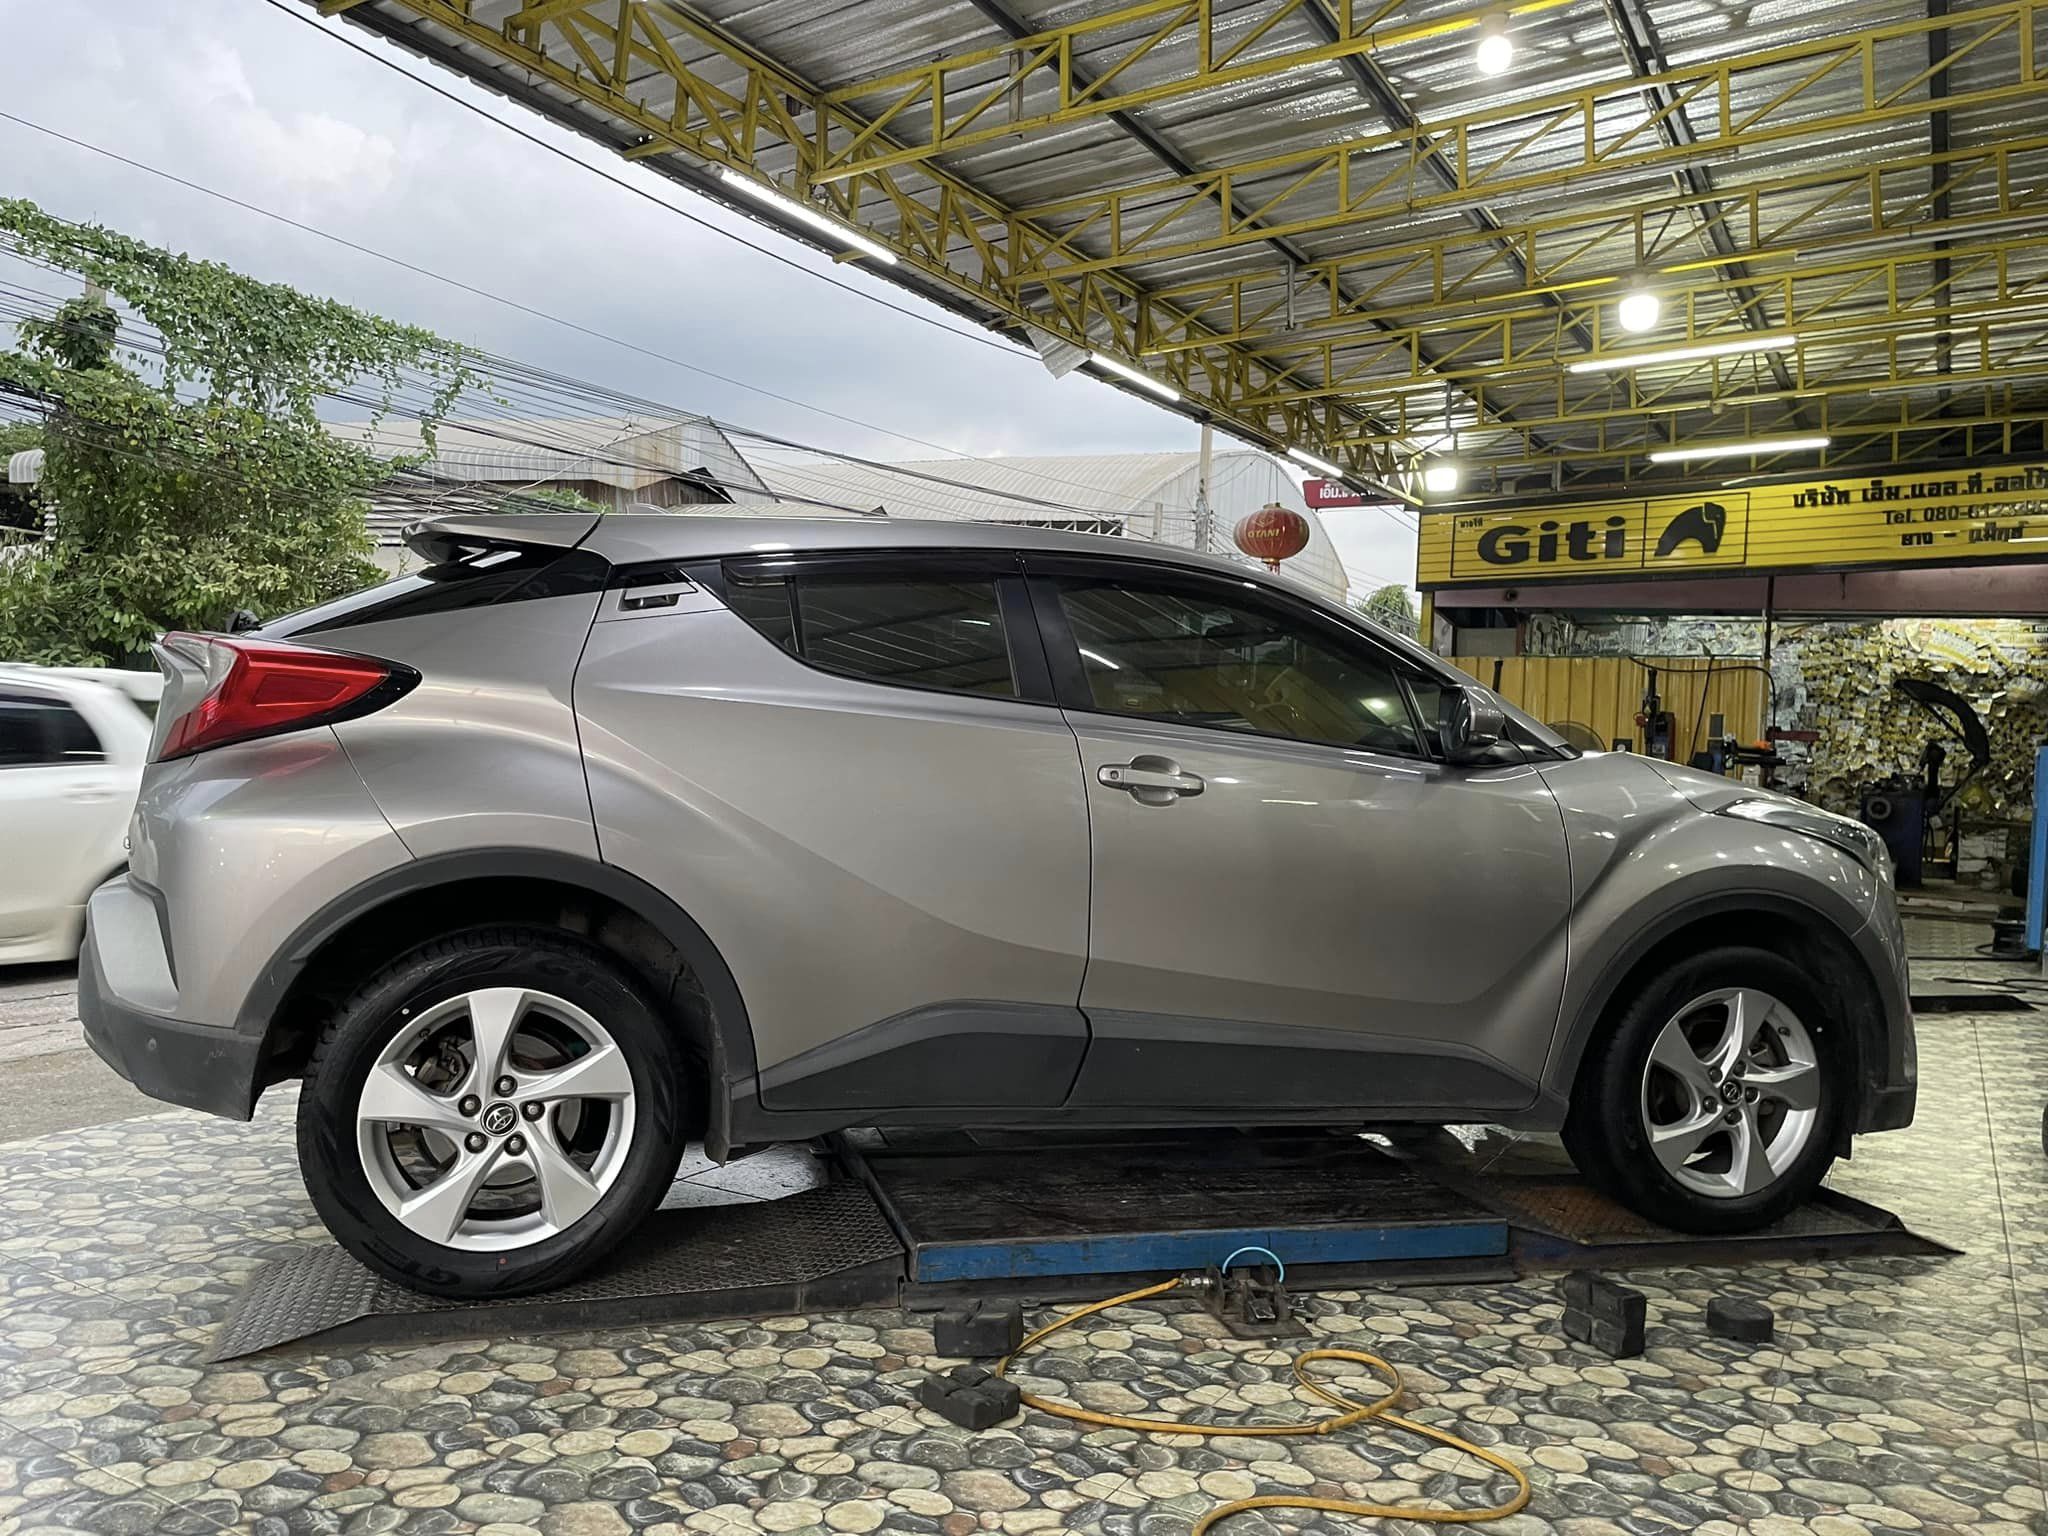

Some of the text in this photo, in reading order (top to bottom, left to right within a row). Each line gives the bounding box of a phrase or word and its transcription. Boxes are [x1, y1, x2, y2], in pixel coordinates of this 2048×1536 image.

[1793, 485, 1850, 508] บริษัท
[1883, 508, 1918, 525] Tel.
[1247, 528, 1281, 539] OTANI
[1477, 516, 1626, 565] Giti
